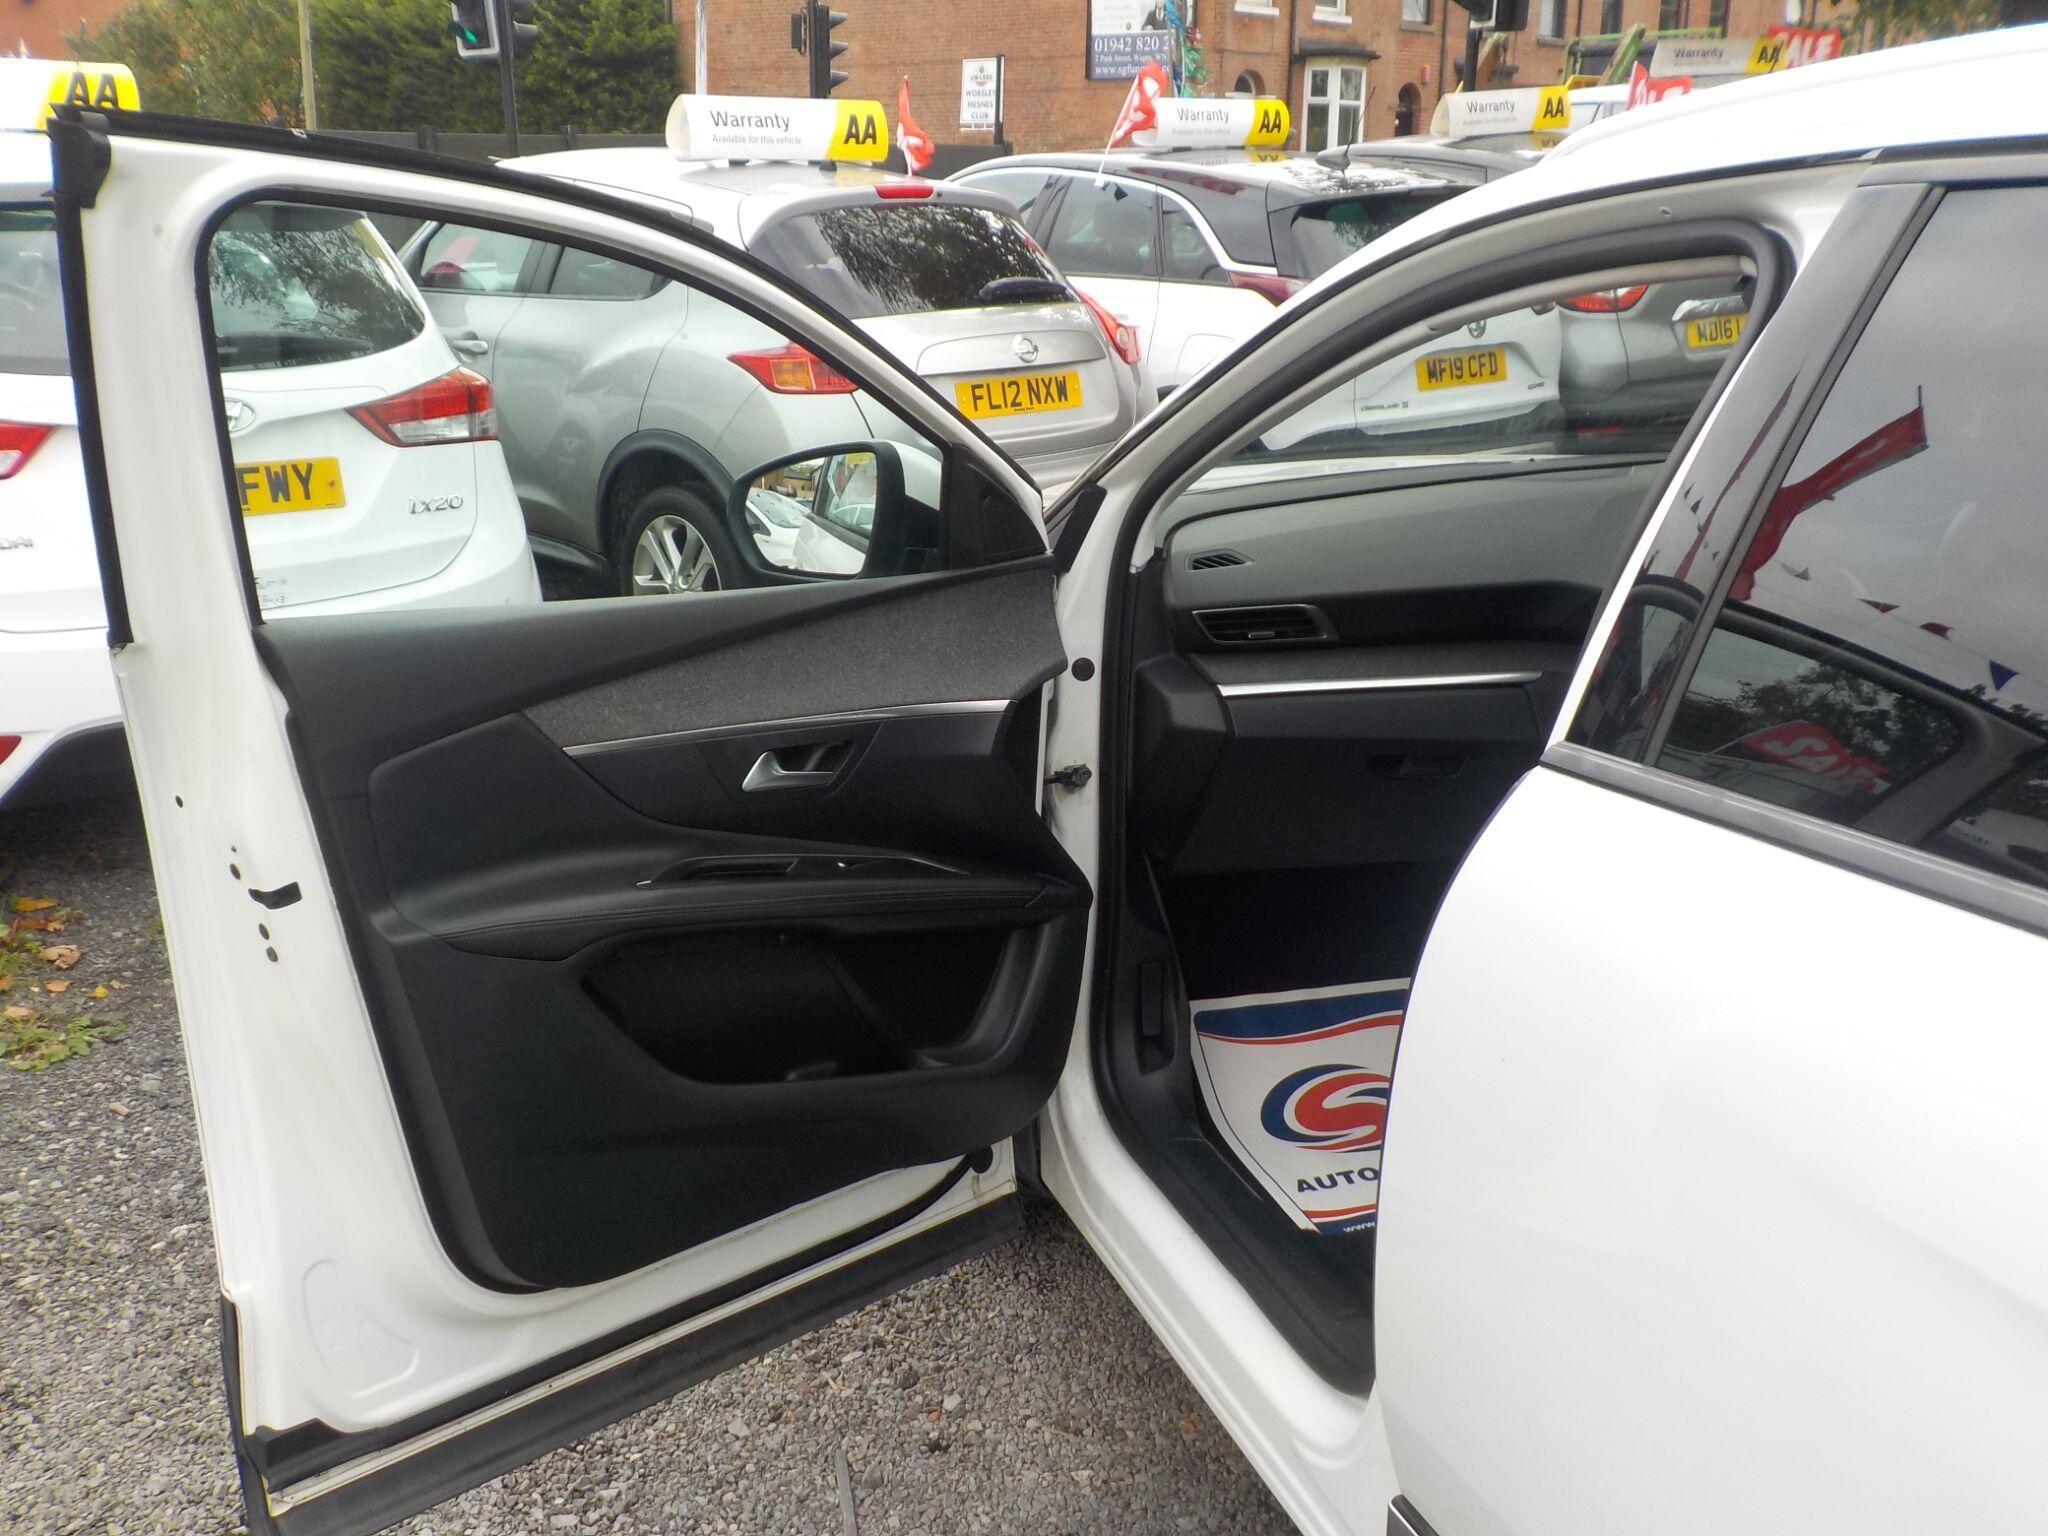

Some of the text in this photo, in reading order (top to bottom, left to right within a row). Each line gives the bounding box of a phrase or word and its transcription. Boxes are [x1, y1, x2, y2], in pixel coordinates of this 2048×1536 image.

[1094, 37, 1132, 52] 01942
[1136, 36, 1159, 51] 820
[1674, 46, 1724, 58] Warranty
[65, 71, 119, 108] AA
[971, 111, 989, 119] CLUB
[1176, 107, 1230, 124] Warranty
[1466, 99, 1516, 113] Warranty
[1543, 97, 1565, 118] AA
[710, 110, 790, 132] Warranty
[843, 114, 877, 145] AA
[1258, 109, 1282, 133] AA
[712, 134, 802, 145] Available for this vehicle
[1696, 319, 1733, 343] MD16
[1427, 351, 1498, 384] MF19 CFD
[970, 375, 1069, 412] FL12 NXW
[235, 462, 313, 505] FWY
